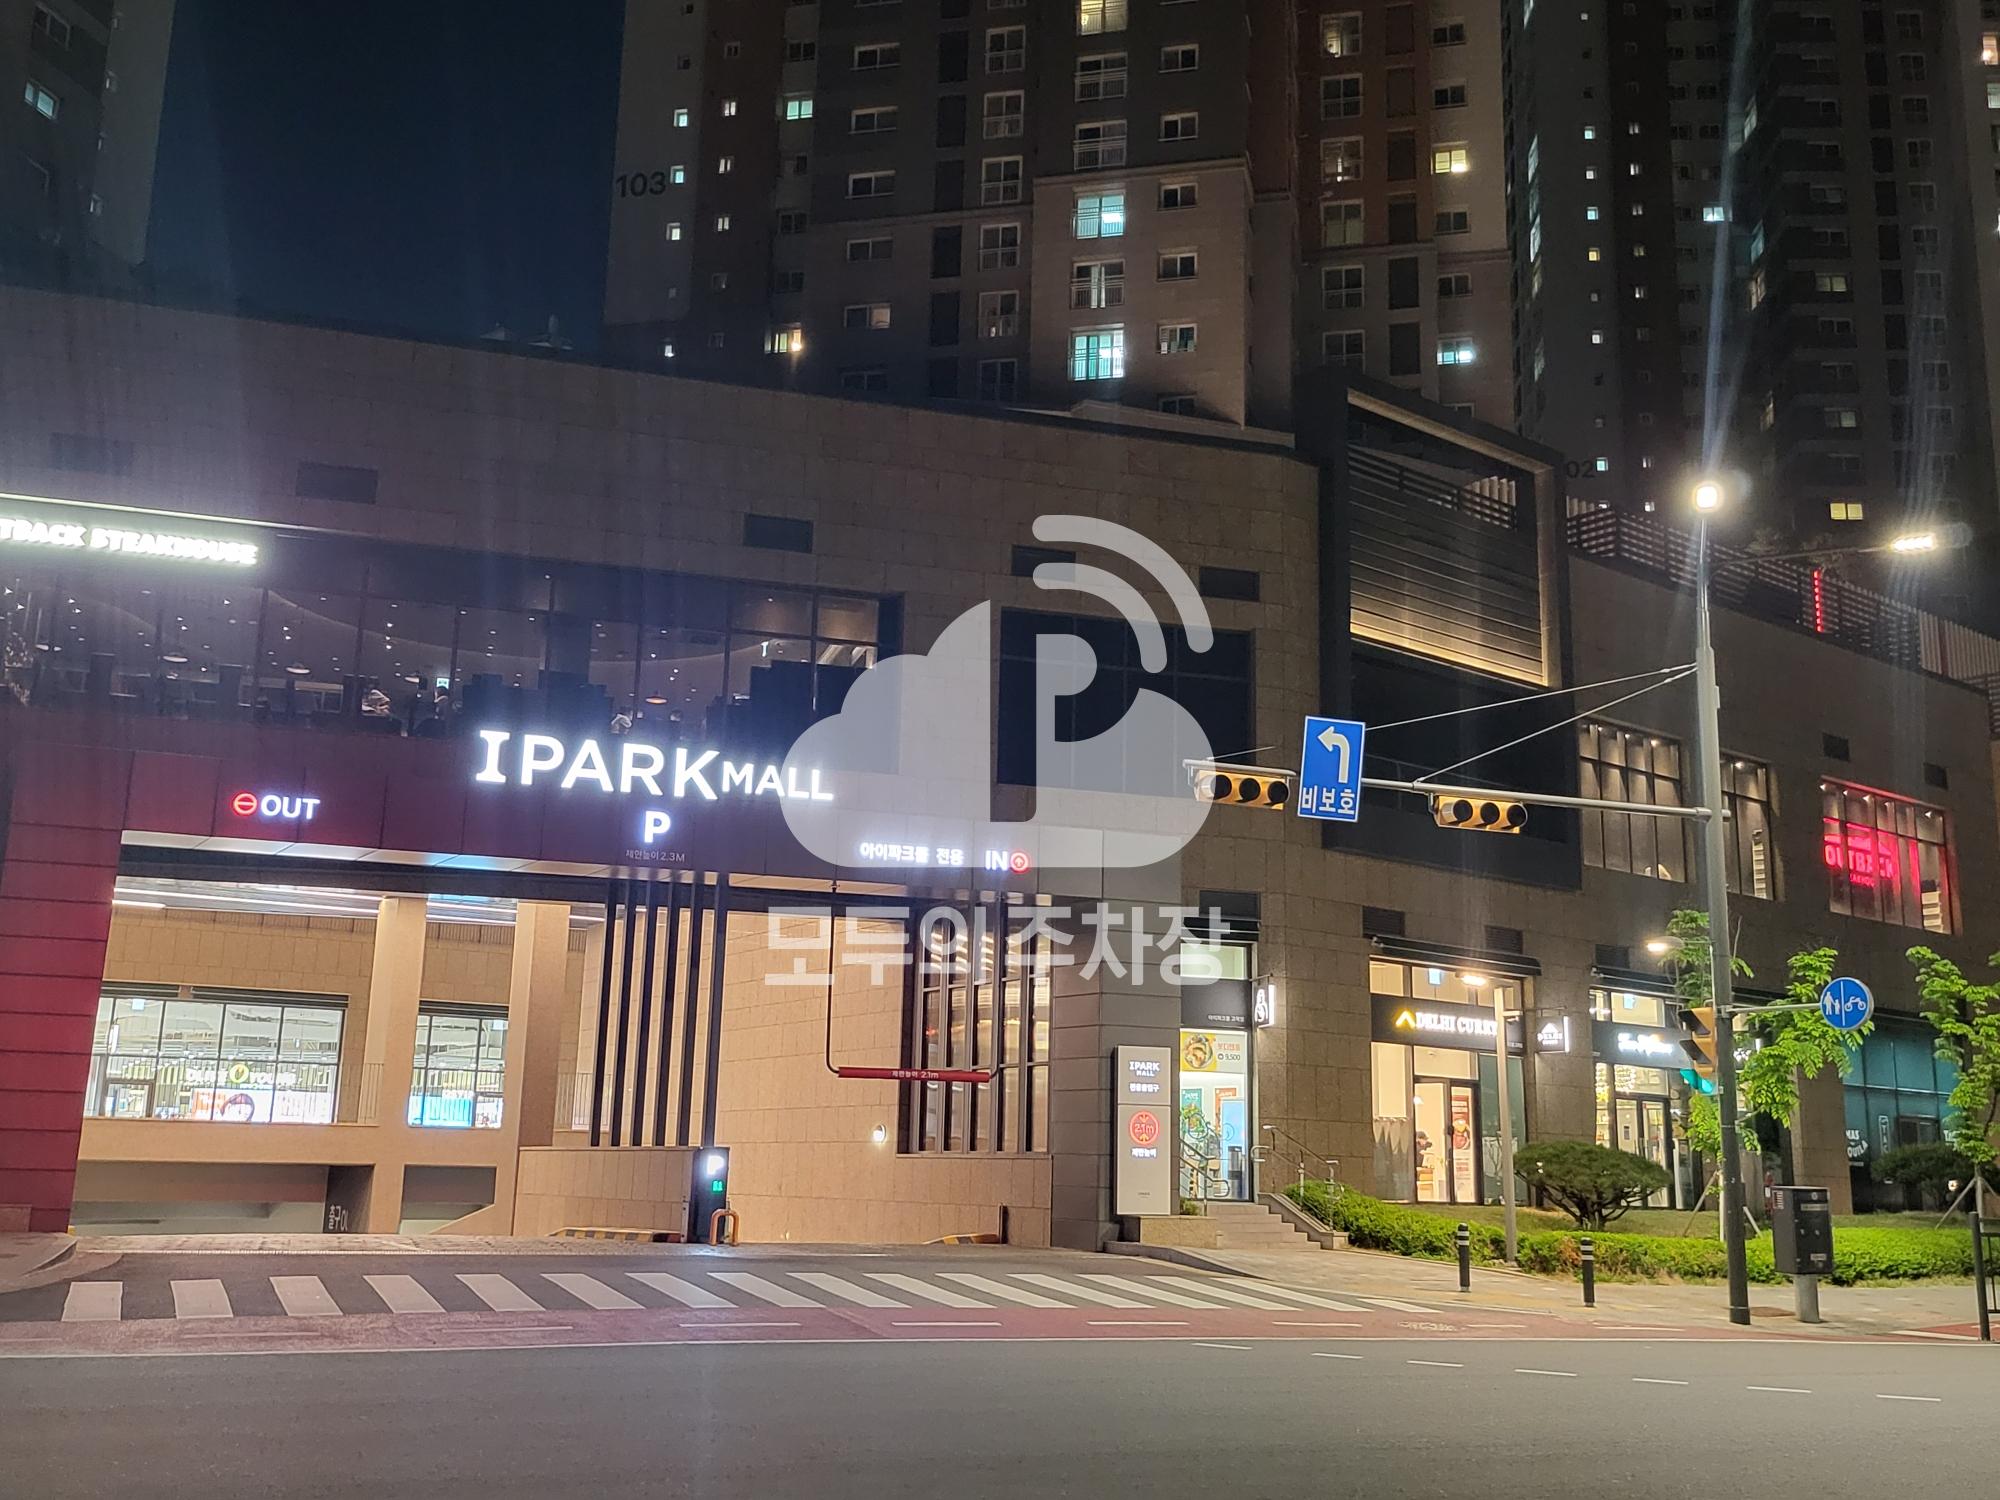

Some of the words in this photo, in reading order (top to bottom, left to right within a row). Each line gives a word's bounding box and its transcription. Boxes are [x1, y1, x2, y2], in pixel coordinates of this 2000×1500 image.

[616, 172, 666, 198] 103
[89, 527, 258, 566] STEAKHOUSE
[475, 729, 720, 800] IPARK
[721, 760, 834, 801] MALL
[260, 794, 321, 820] OUT
[1302, 785, 1355, 815] 비보호
[643, 810, 671, 843] P
[859, 842, 930, 864] 아이파크몰
[935, 848, 964, 866] 전용
[985, 850, 1008, 871] IN
[1415, 1011, 1456, 1033] DELHI
[1129, 1061, 1160, 1071] IPARK
